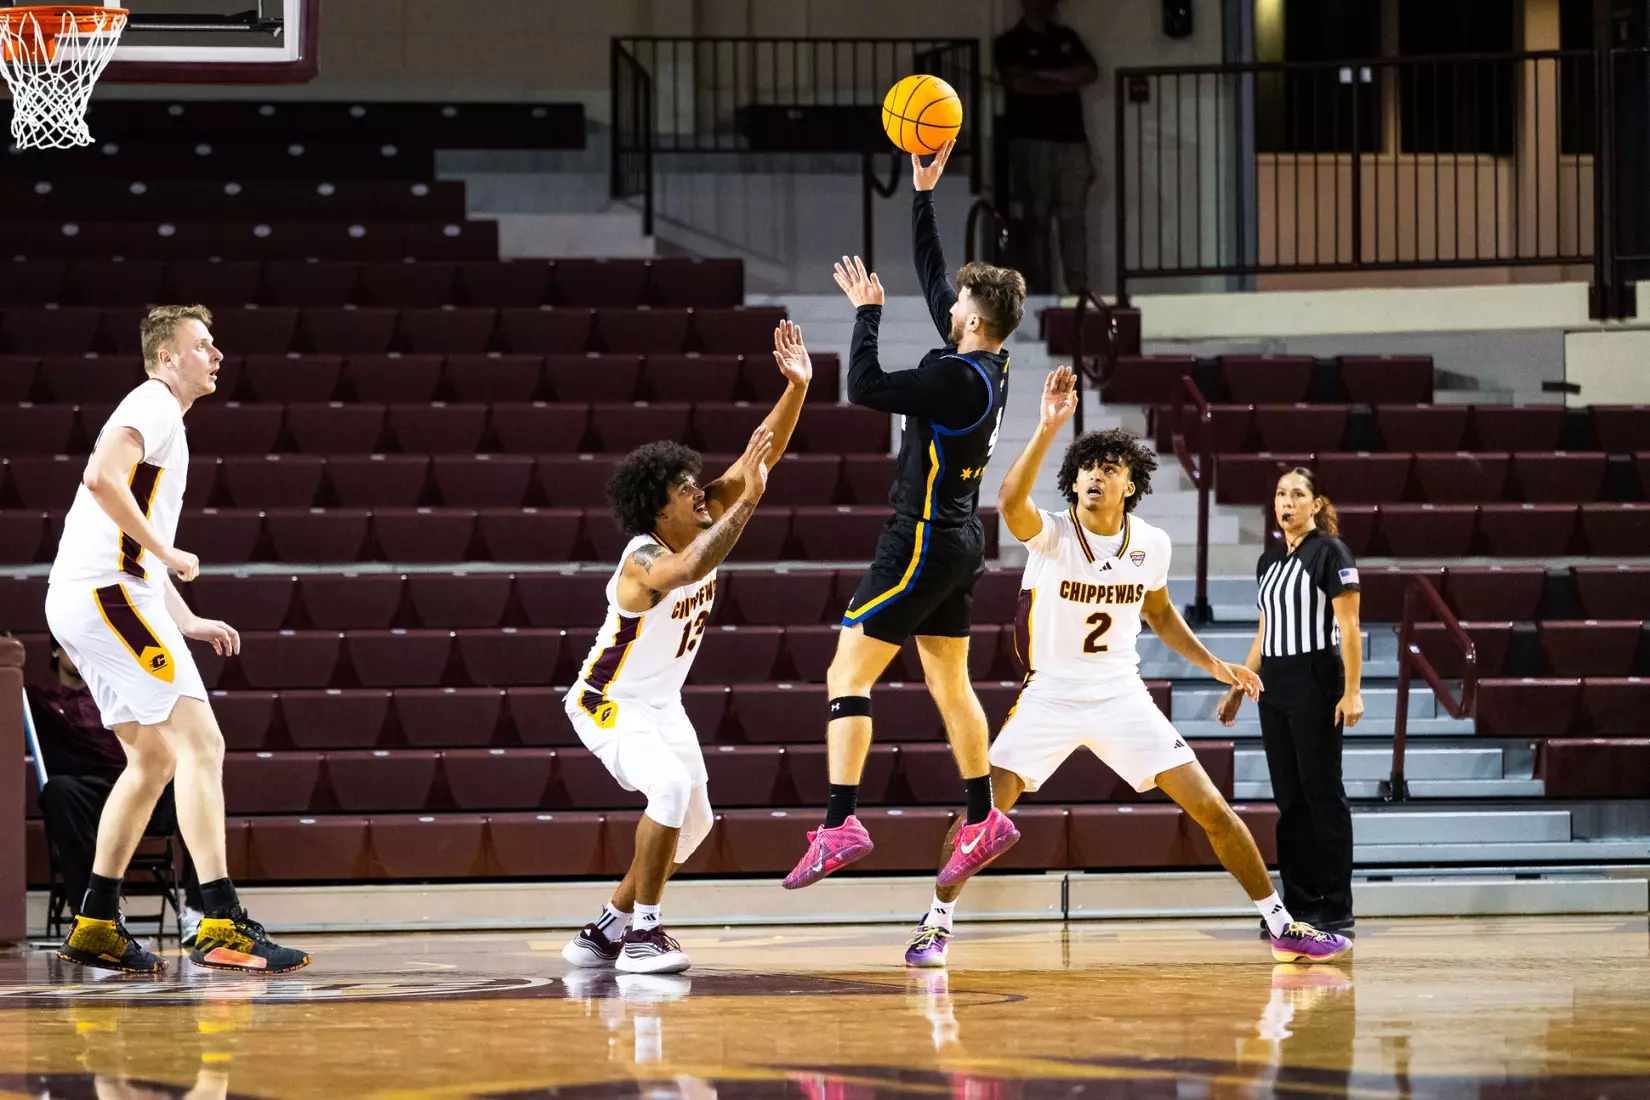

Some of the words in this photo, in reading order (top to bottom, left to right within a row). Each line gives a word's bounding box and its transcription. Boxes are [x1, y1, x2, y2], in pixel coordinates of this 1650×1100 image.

[1059, 580, 1144, 605] CHIPPEWAS
[674, 609, 710, 659] 13
[1082, 611, 1113, 654] 2
